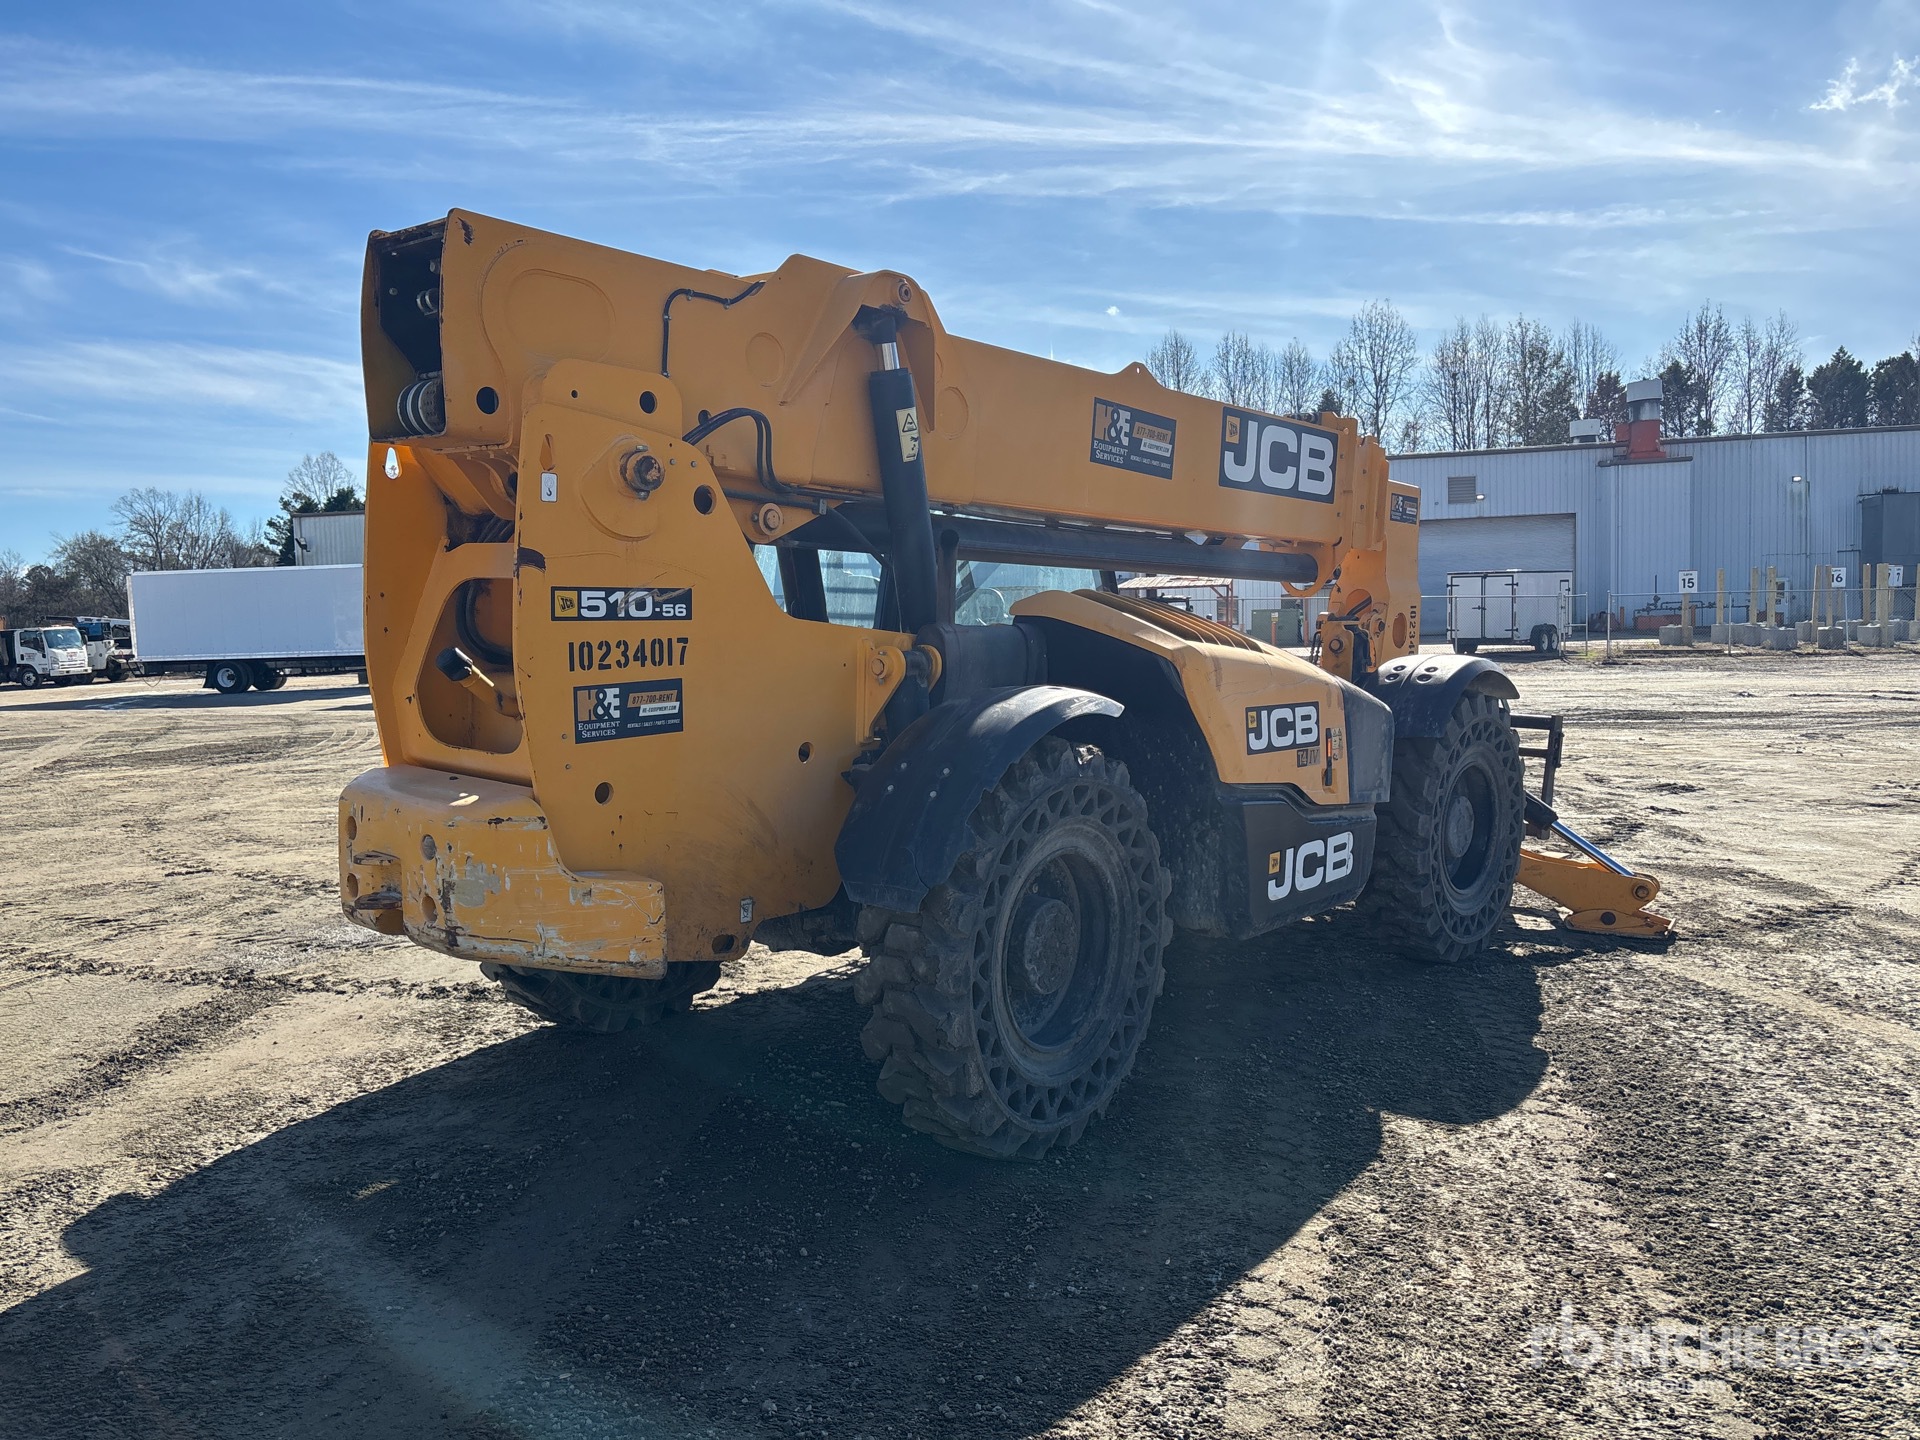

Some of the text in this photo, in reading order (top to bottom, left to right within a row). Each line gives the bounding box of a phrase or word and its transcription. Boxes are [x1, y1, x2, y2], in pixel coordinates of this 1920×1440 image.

[1094, 403, 1131, 446] H&E
[1093, 440, 1129, 456] EQUIPMENT
[1095, 449, 1124, 464] SERVICES
[1224, 420, 1333, 496] JCB
[1681, 577, 1695, 589] 15
[1831, 573, 1844, 583] 16
[580, 590, 687, 618] 510-56
[568, 637, 689, 672] 10234017
[577, 687, 621, 722] H&E
[578, 720, 621, 731] EQUIPMENT
[581, 728, 616, 739] SERVICES
[1248, 705, 1318, 750] JCB
[1267, 831, 1354, 901] JCB
